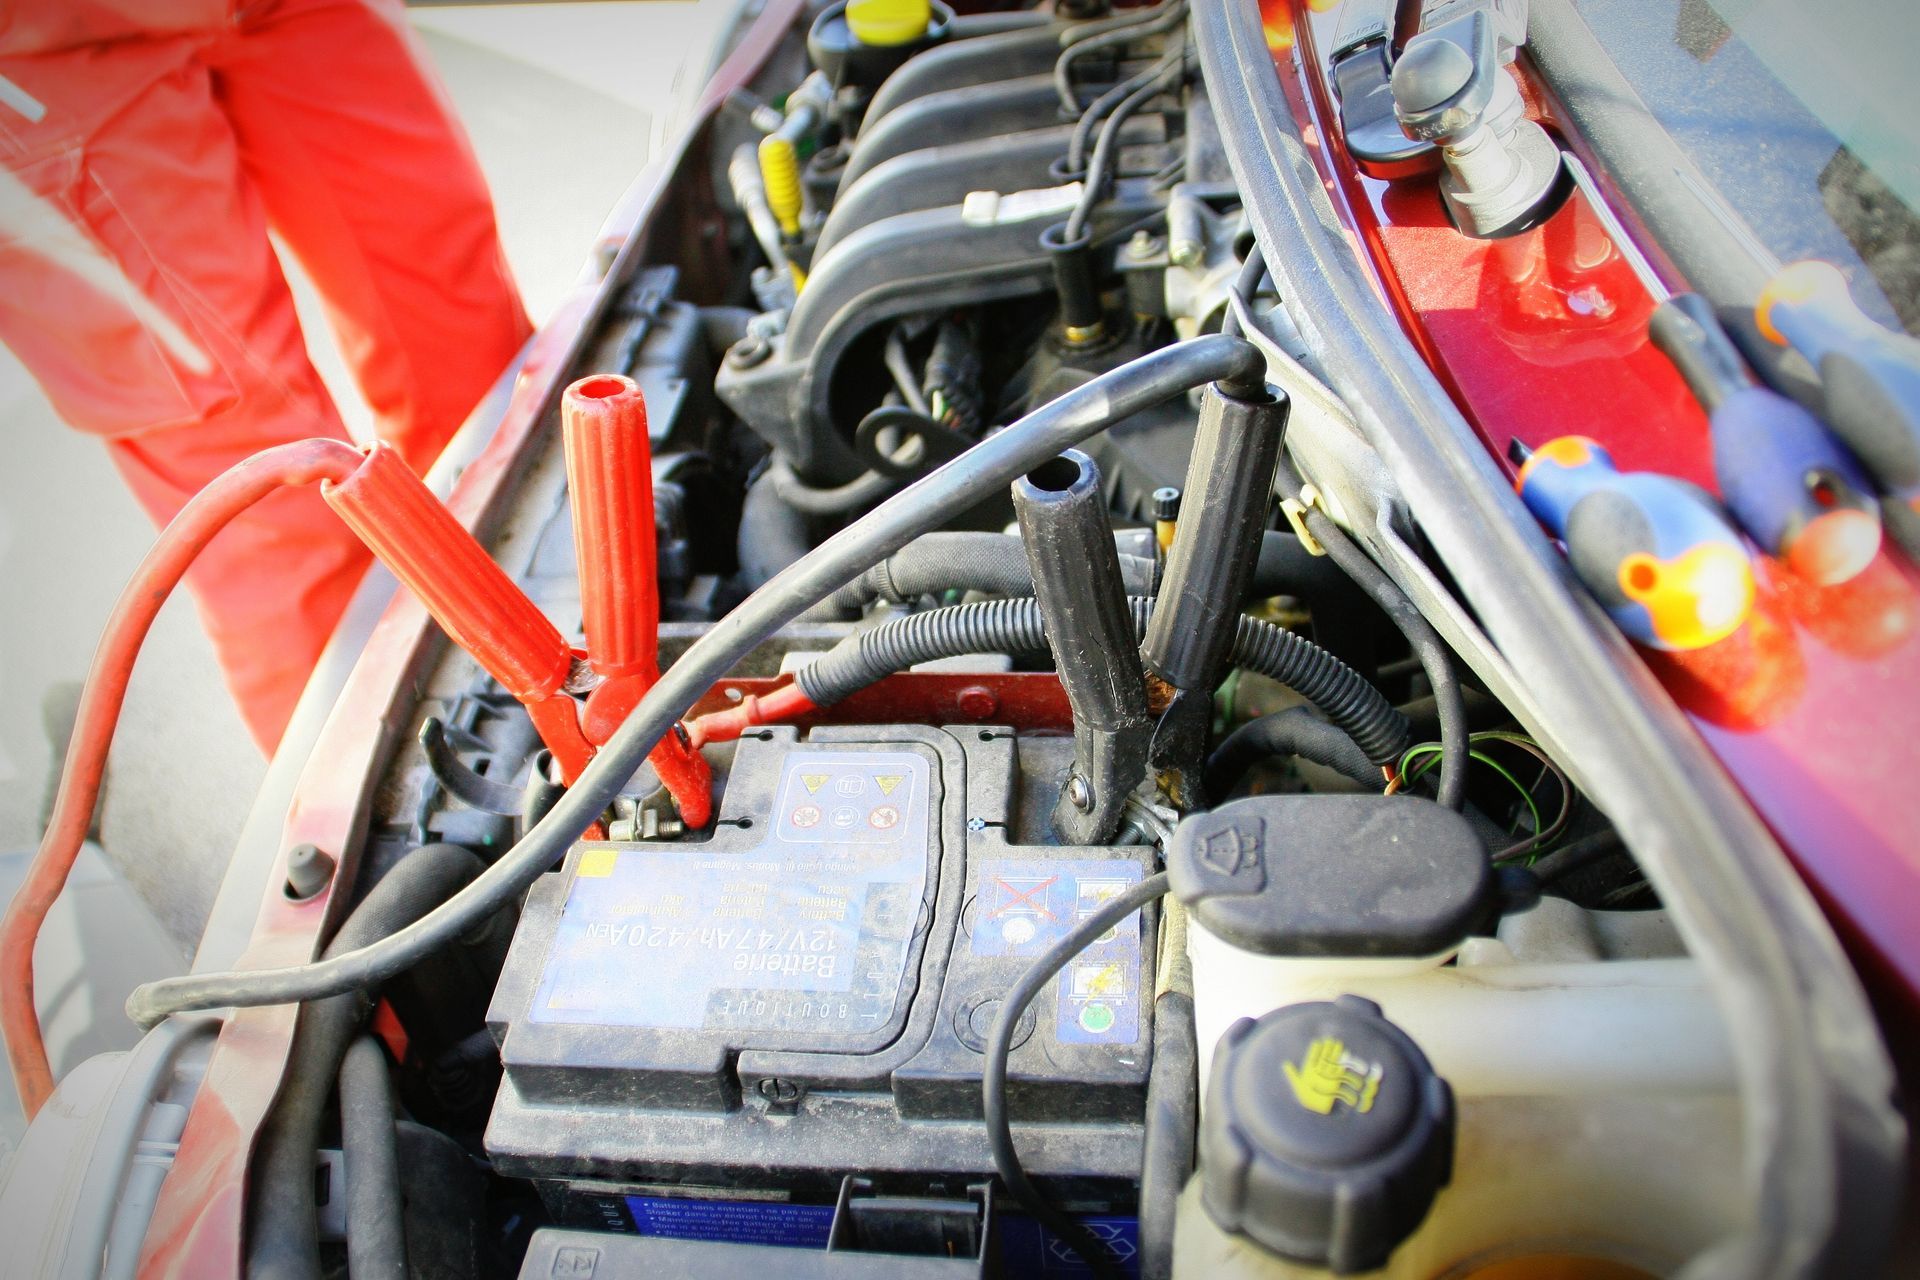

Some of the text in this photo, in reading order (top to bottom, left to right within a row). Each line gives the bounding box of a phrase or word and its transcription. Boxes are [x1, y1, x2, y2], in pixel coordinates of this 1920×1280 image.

[732, 953, 835, 979] Batterie
[860, 895, 897, 1020] EAULT
[720, 999, 848, 1019] BOUTIQUE
[780, 1208, 799, 1217] pas
